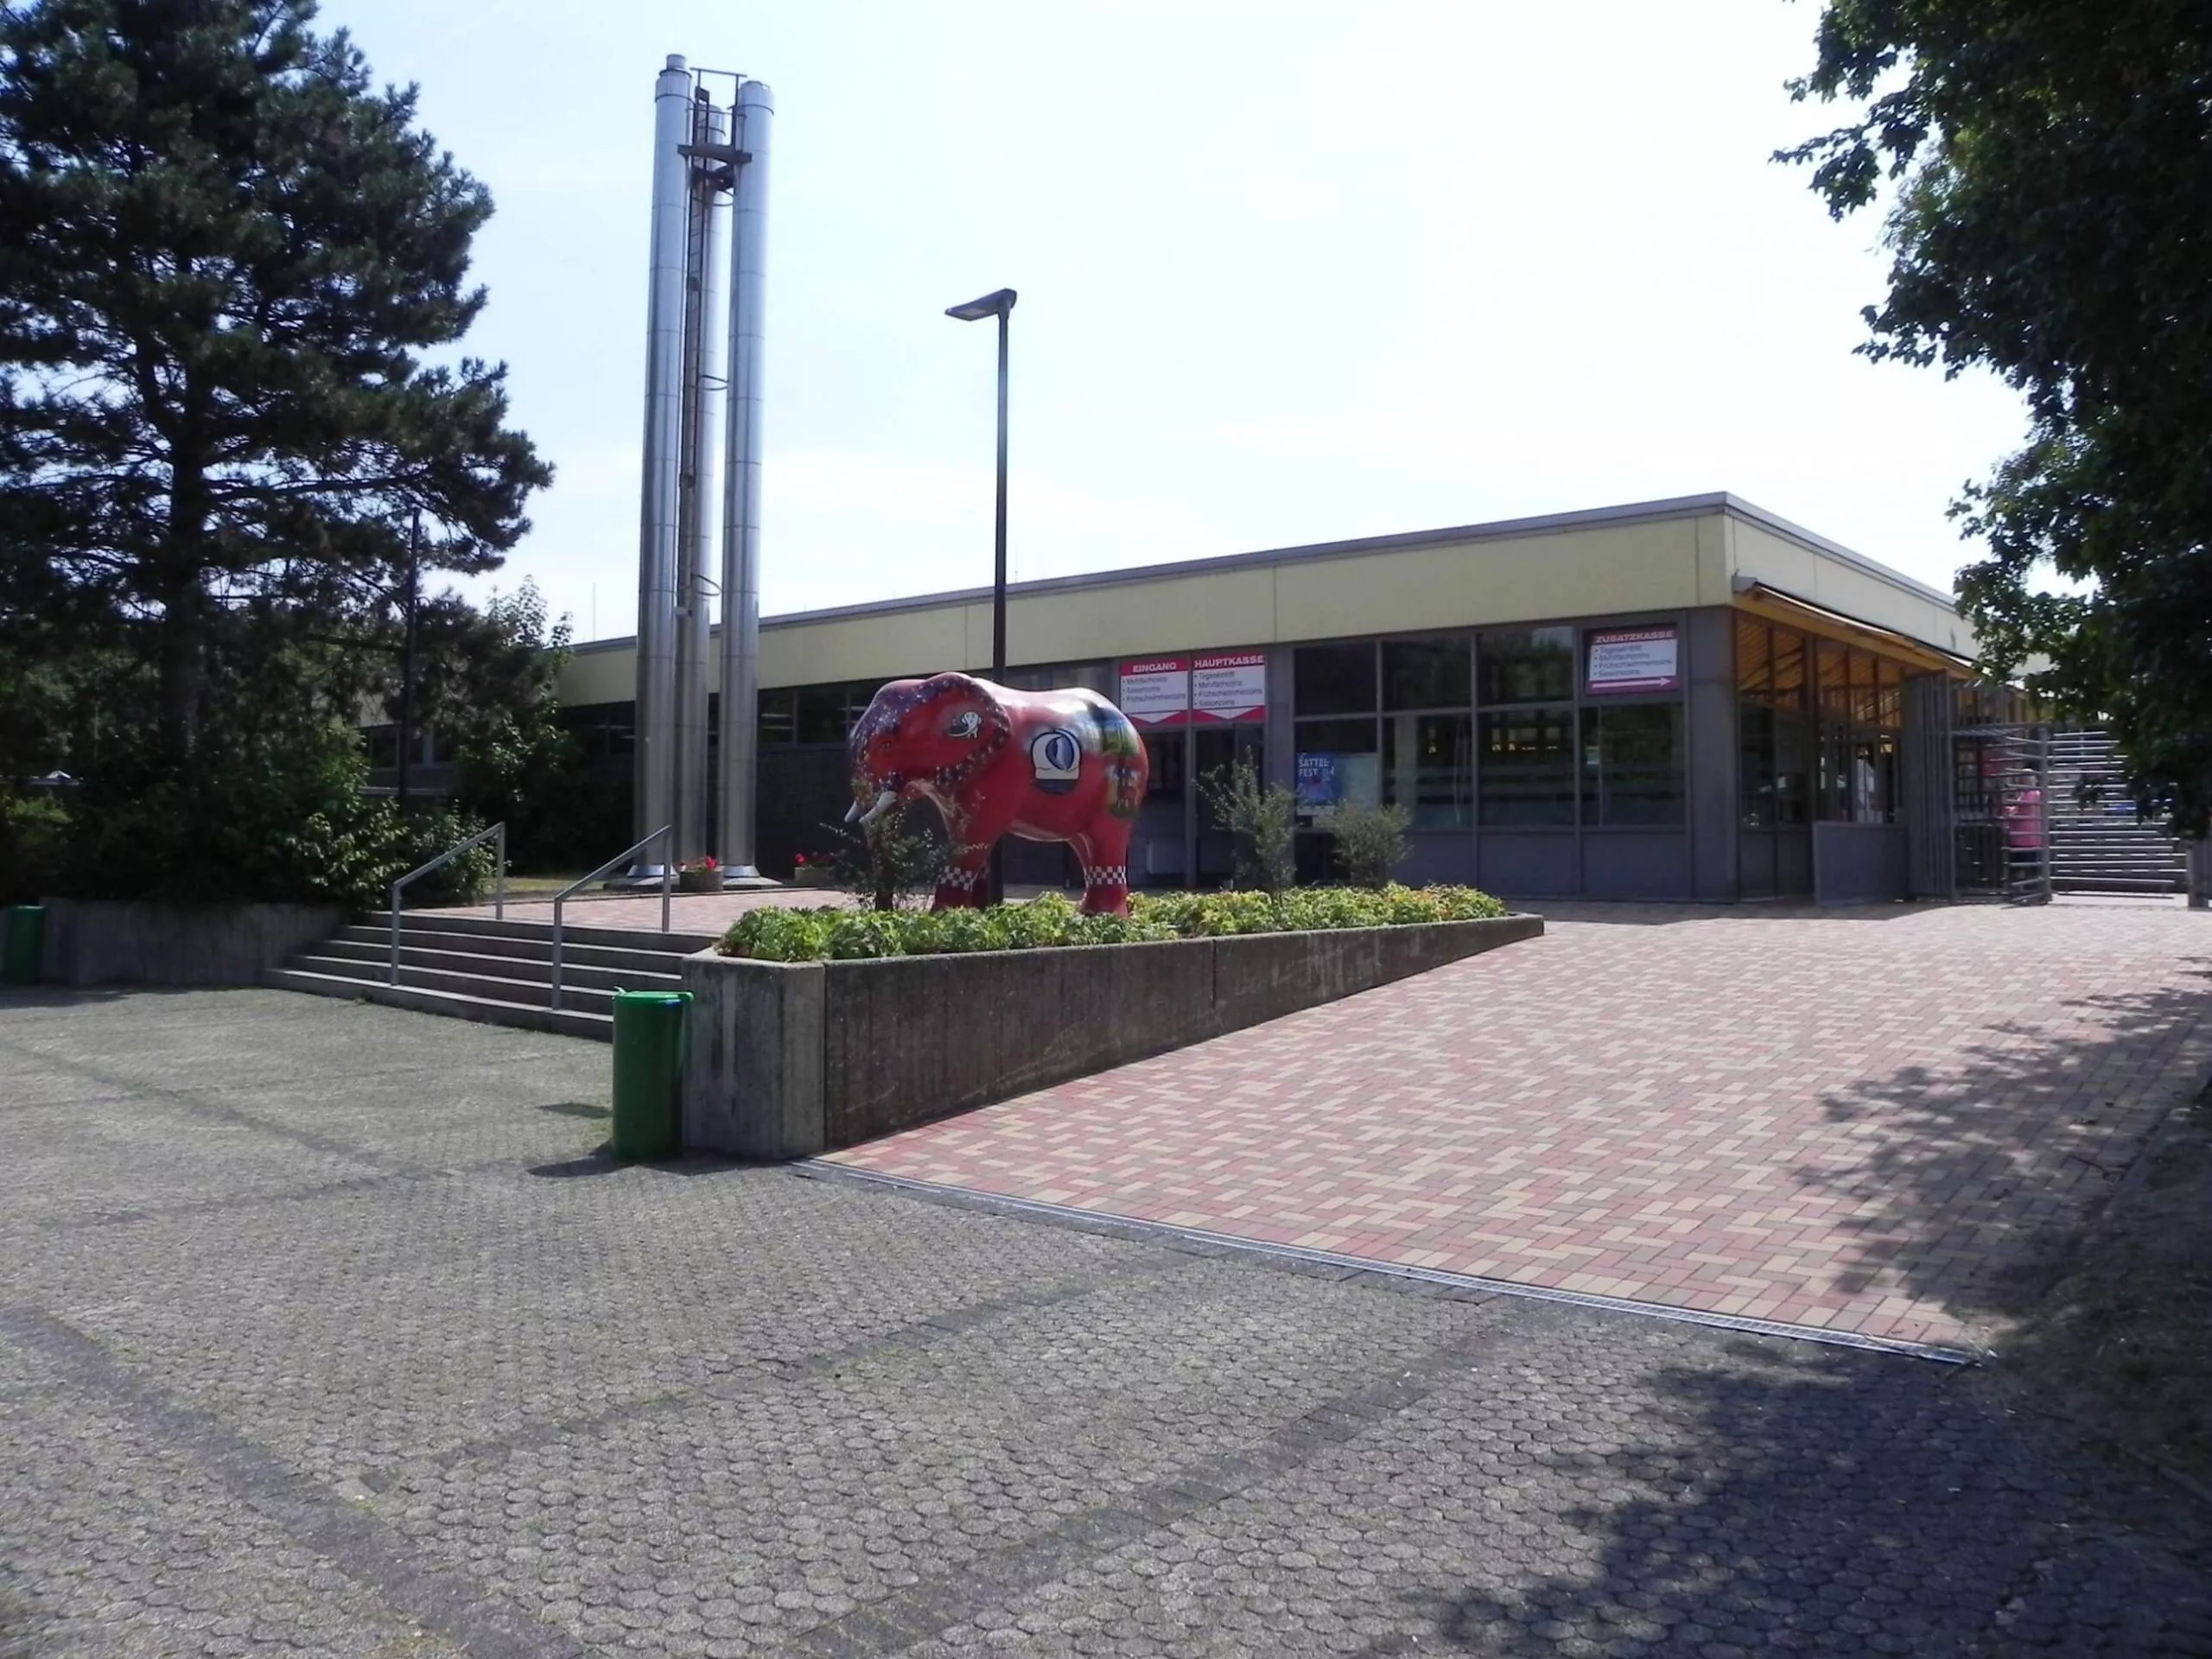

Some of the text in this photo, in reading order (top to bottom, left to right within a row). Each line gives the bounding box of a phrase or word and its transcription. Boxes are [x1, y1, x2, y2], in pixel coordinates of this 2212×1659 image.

[1596, 630, 1674, 643] ZUSATZKASSE
[1133, 662, 1177, 673] EINGANG
[1194, 655, 1264, 668] HAUPTKASSE
